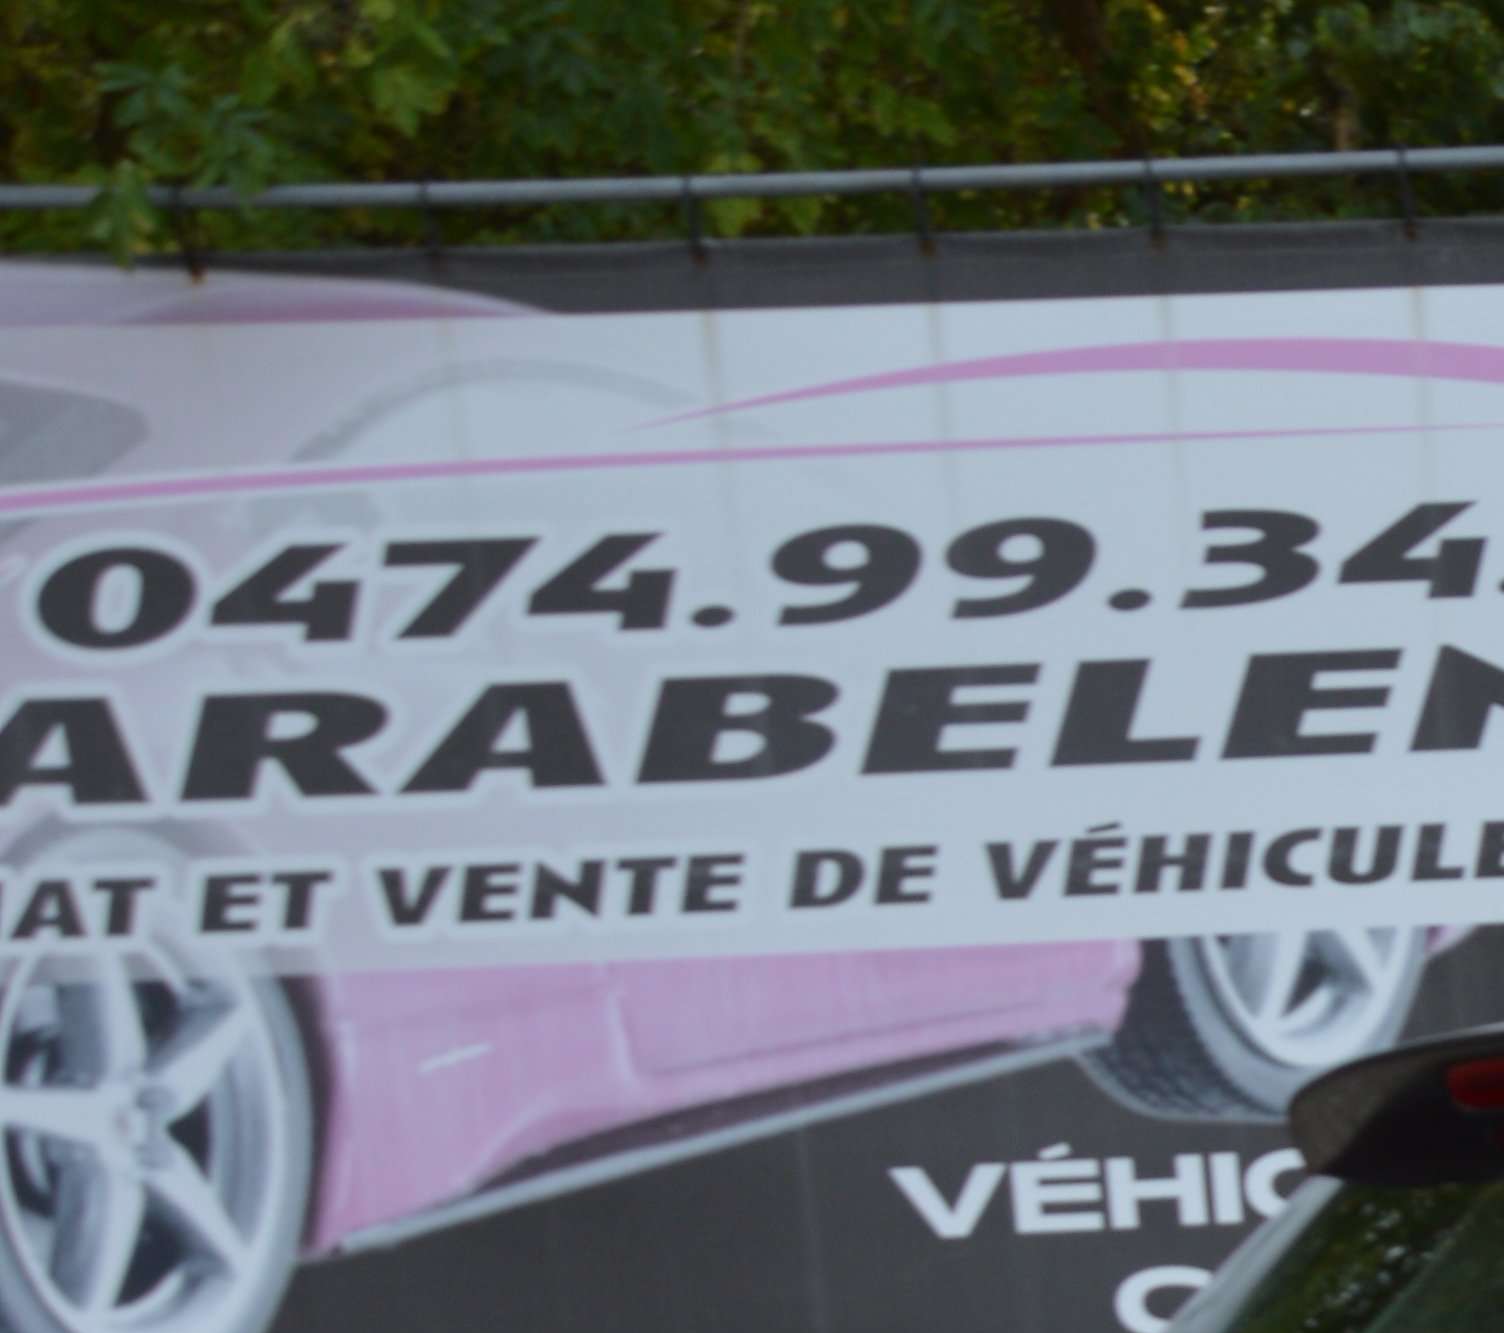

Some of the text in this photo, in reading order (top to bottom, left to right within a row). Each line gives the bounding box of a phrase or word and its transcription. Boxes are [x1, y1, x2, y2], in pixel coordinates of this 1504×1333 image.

[0, 877, 154, 940] AT
[199, 870, 331, 934] ET
[378, 853, 743, 926] VENTE
[790, 845, 937, 909] DE
[889, 1142, 1308, 1240] VÉHIC
